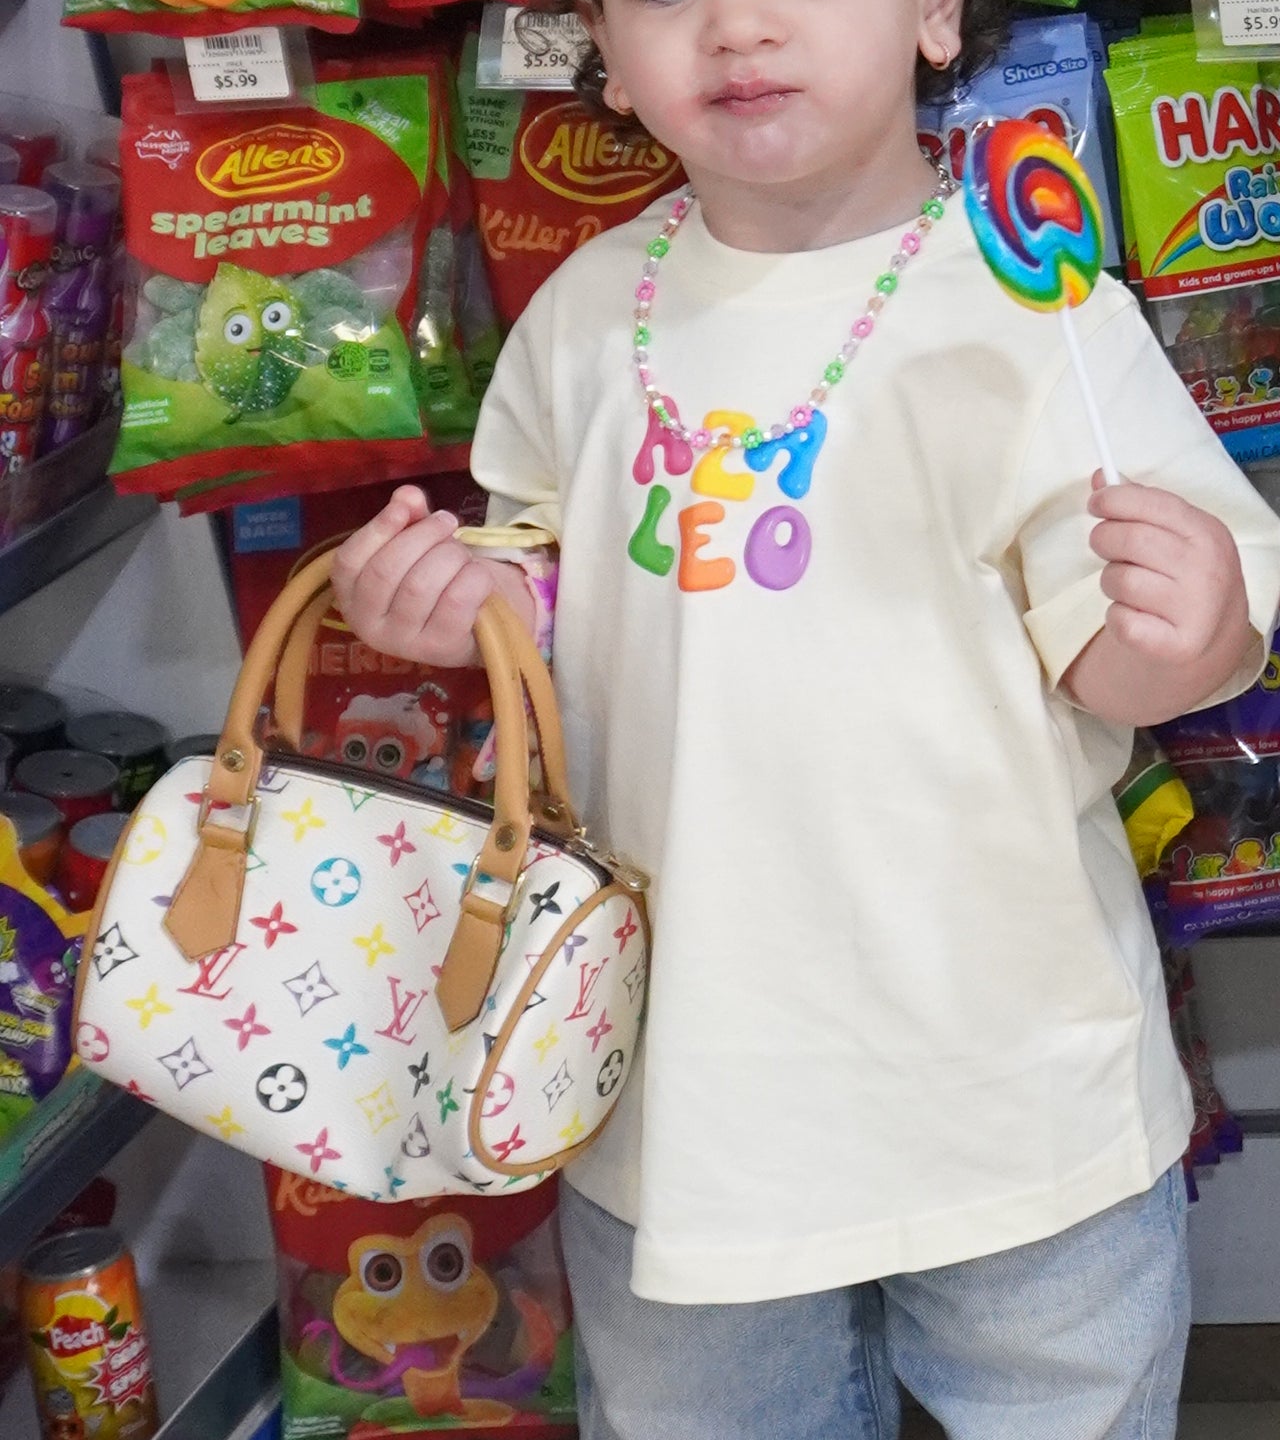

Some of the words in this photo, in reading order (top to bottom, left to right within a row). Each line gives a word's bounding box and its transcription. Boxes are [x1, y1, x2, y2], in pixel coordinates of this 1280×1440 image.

[214, 72, 257, 90] $5.99
[218, 136, 335, 185] Allen's
[150, 194, 374, 241] spearmint
[192, 223, 330, 260] leaves
[626, 484, 814, 594] LEO
[49, 1323, 106, 1354] Peach
